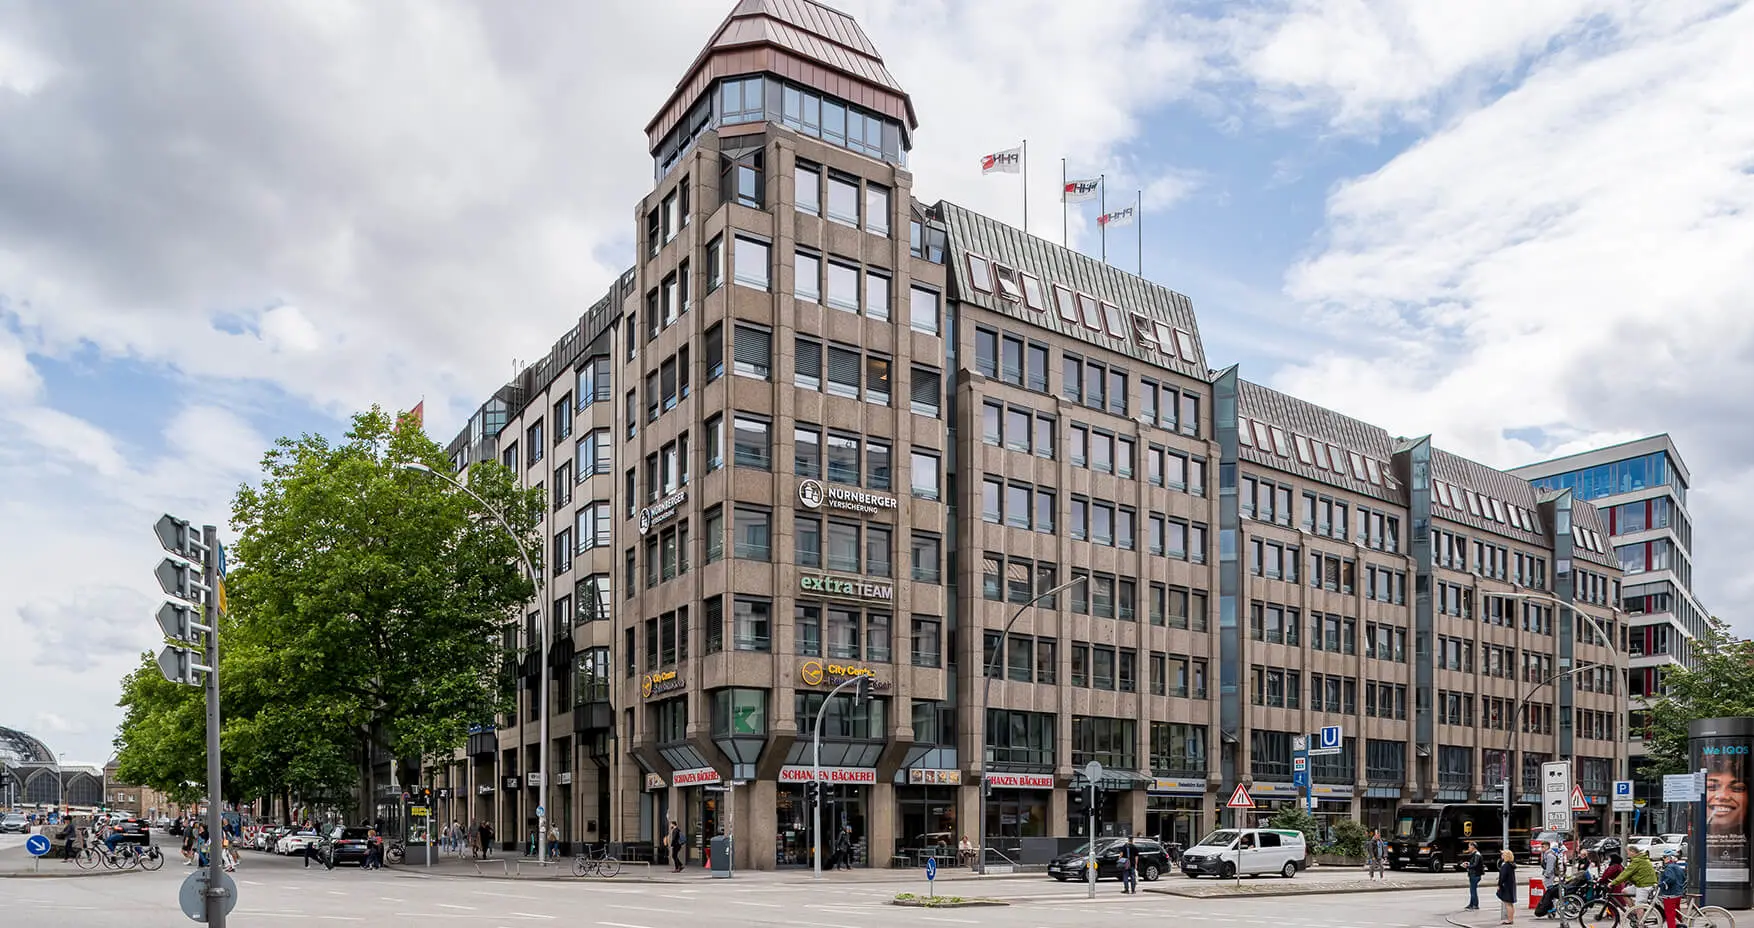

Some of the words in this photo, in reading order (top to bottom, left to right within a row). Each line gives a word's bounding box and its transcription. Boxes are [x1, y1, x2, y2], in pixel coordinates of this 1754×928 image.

[828, 486, 897, 508] NÜRNBERGER
[829, 500, 878, 514] VERSICHERUNG
[801, 576, 853, 594] extra
[855, 583, 893, 599] TEAM
[828, 664, 847, 676] City
[1323, 728, 1337, 746] U
[782, 769, 829, 780] SCHANEN
[831, 769, 875, 781] BÄCKEREI
[986, 775, 1018, 786] HANZEN
[1019, 775, 1053, 787] BÄCKEREI
